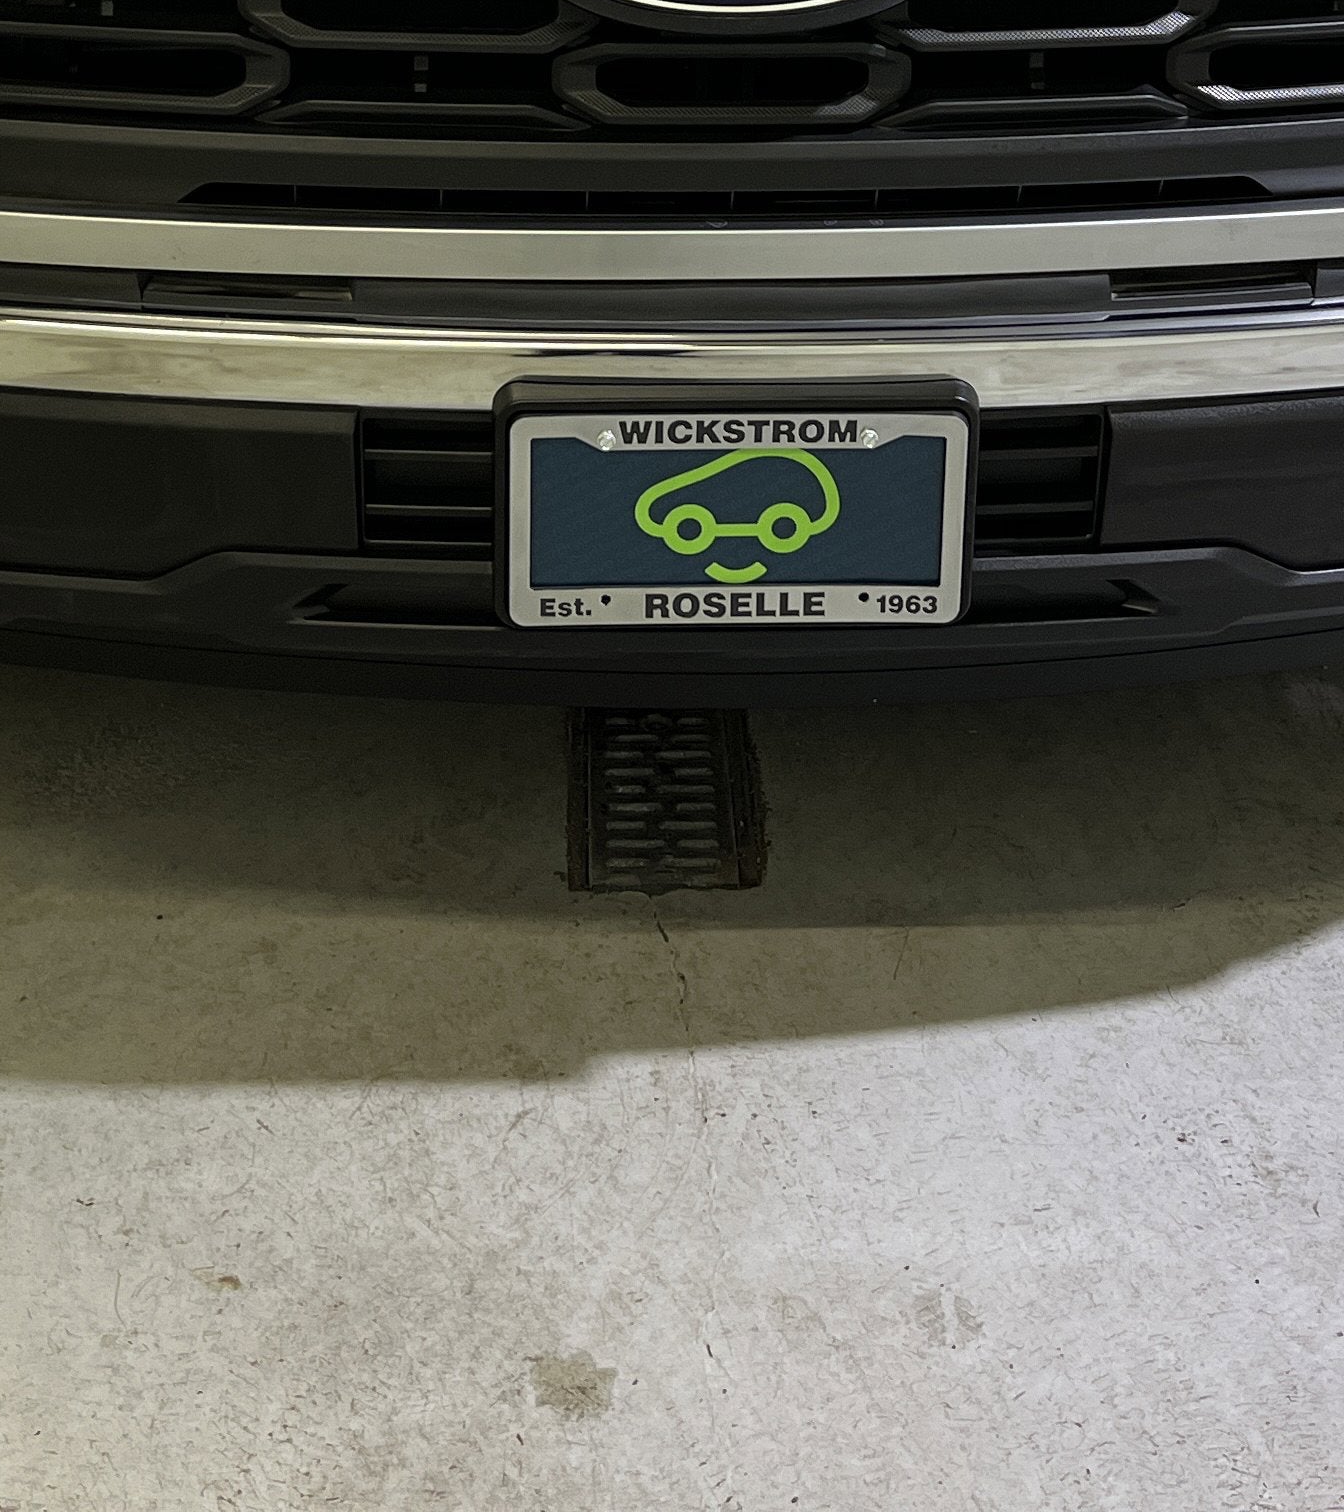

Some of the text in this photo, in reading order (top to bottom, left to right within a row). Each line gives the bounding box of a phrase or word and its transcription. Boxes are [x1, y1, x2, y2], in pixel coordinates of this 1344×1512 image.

[619, 420, 858, 444] WICKSTROM
[540, 593, 939, 619] Est. ROSELLE 1963
